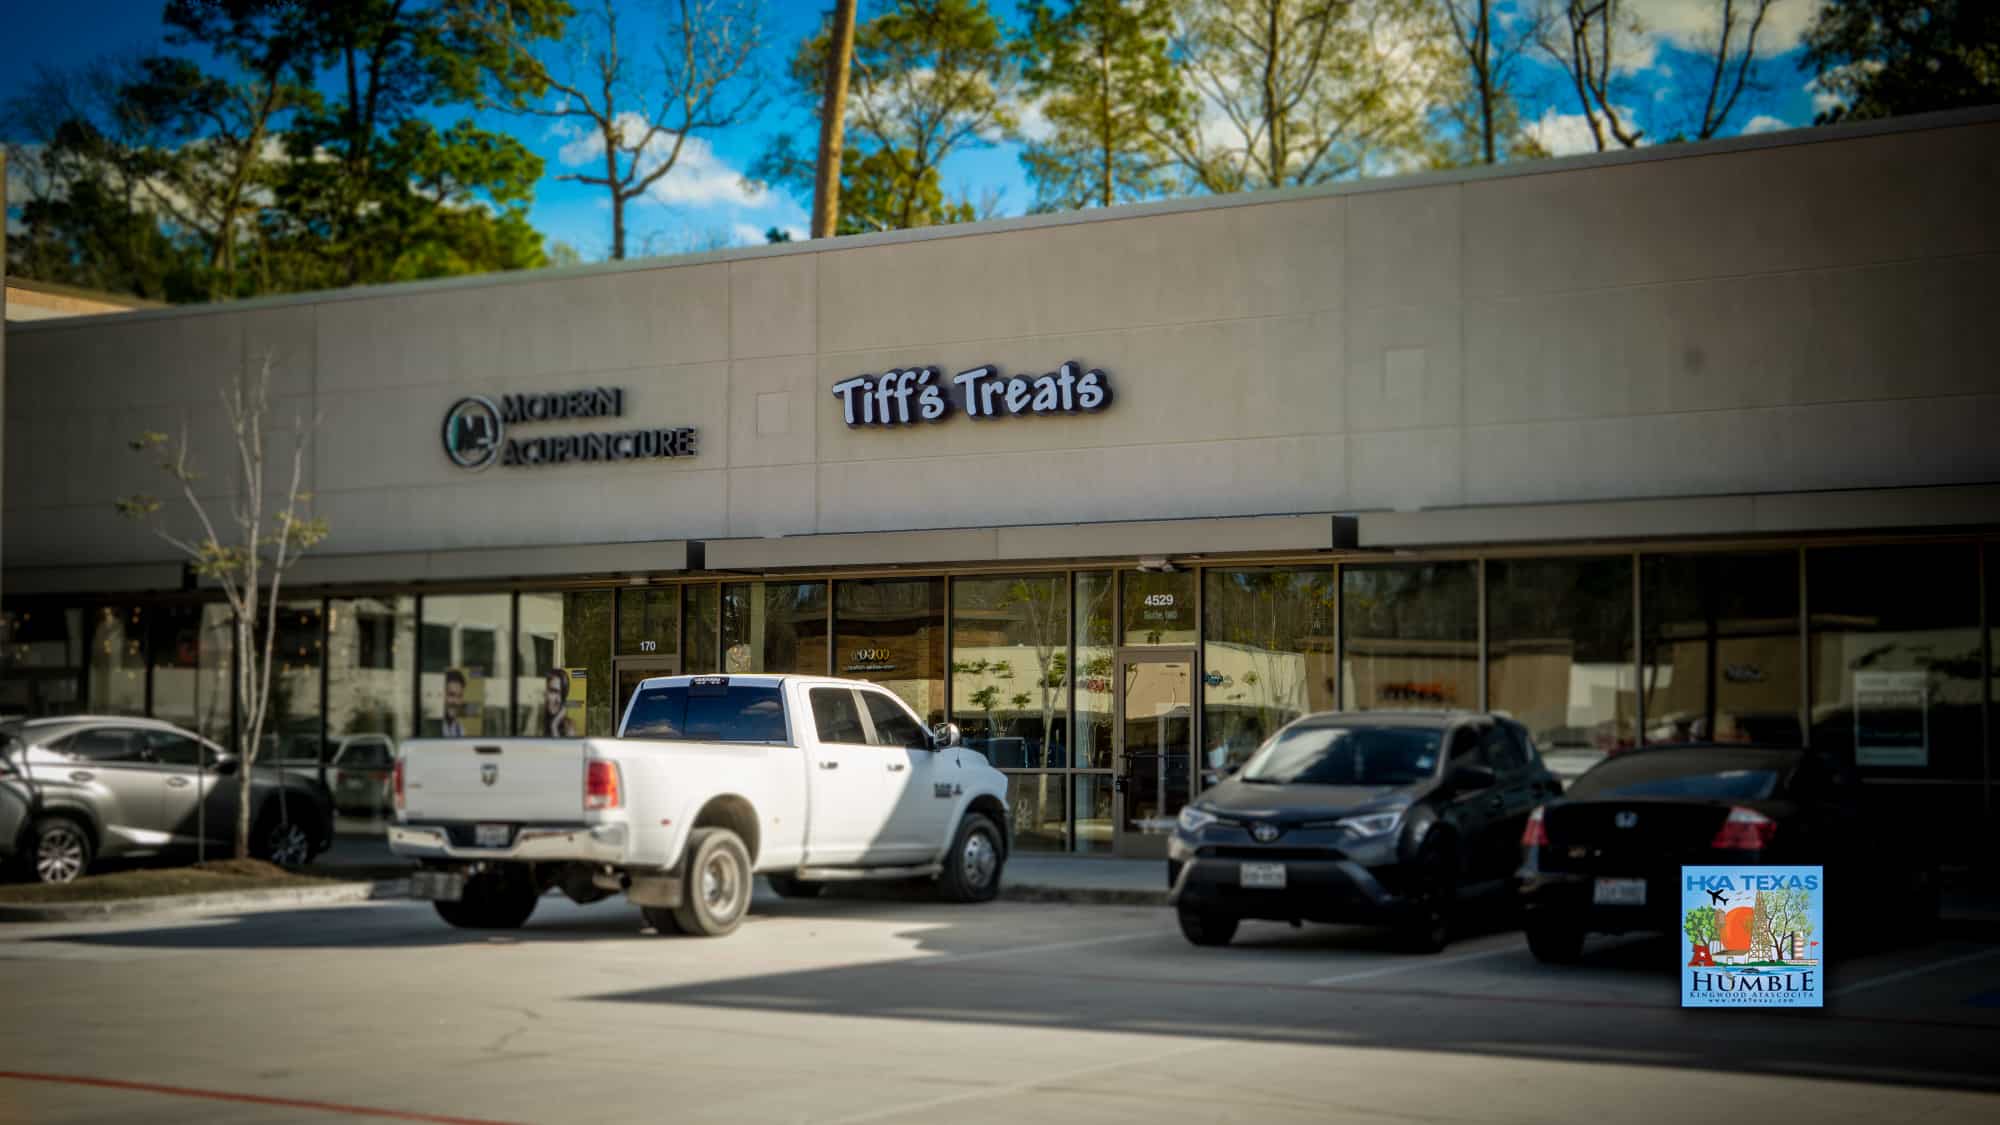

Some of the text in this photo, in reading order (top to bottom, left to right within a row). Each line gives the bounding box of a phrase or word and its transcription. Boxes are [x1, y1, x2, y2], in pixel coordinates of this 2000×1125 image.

[502, 387, 624, 423] MODERN
[832, 364, 1105, 424] Tiff's Treats
[502, 424, 697, 466] ACUPUNCTURE
[1144, 594, 1174, 606] 4529
[640, 641, 656, 651] 170
